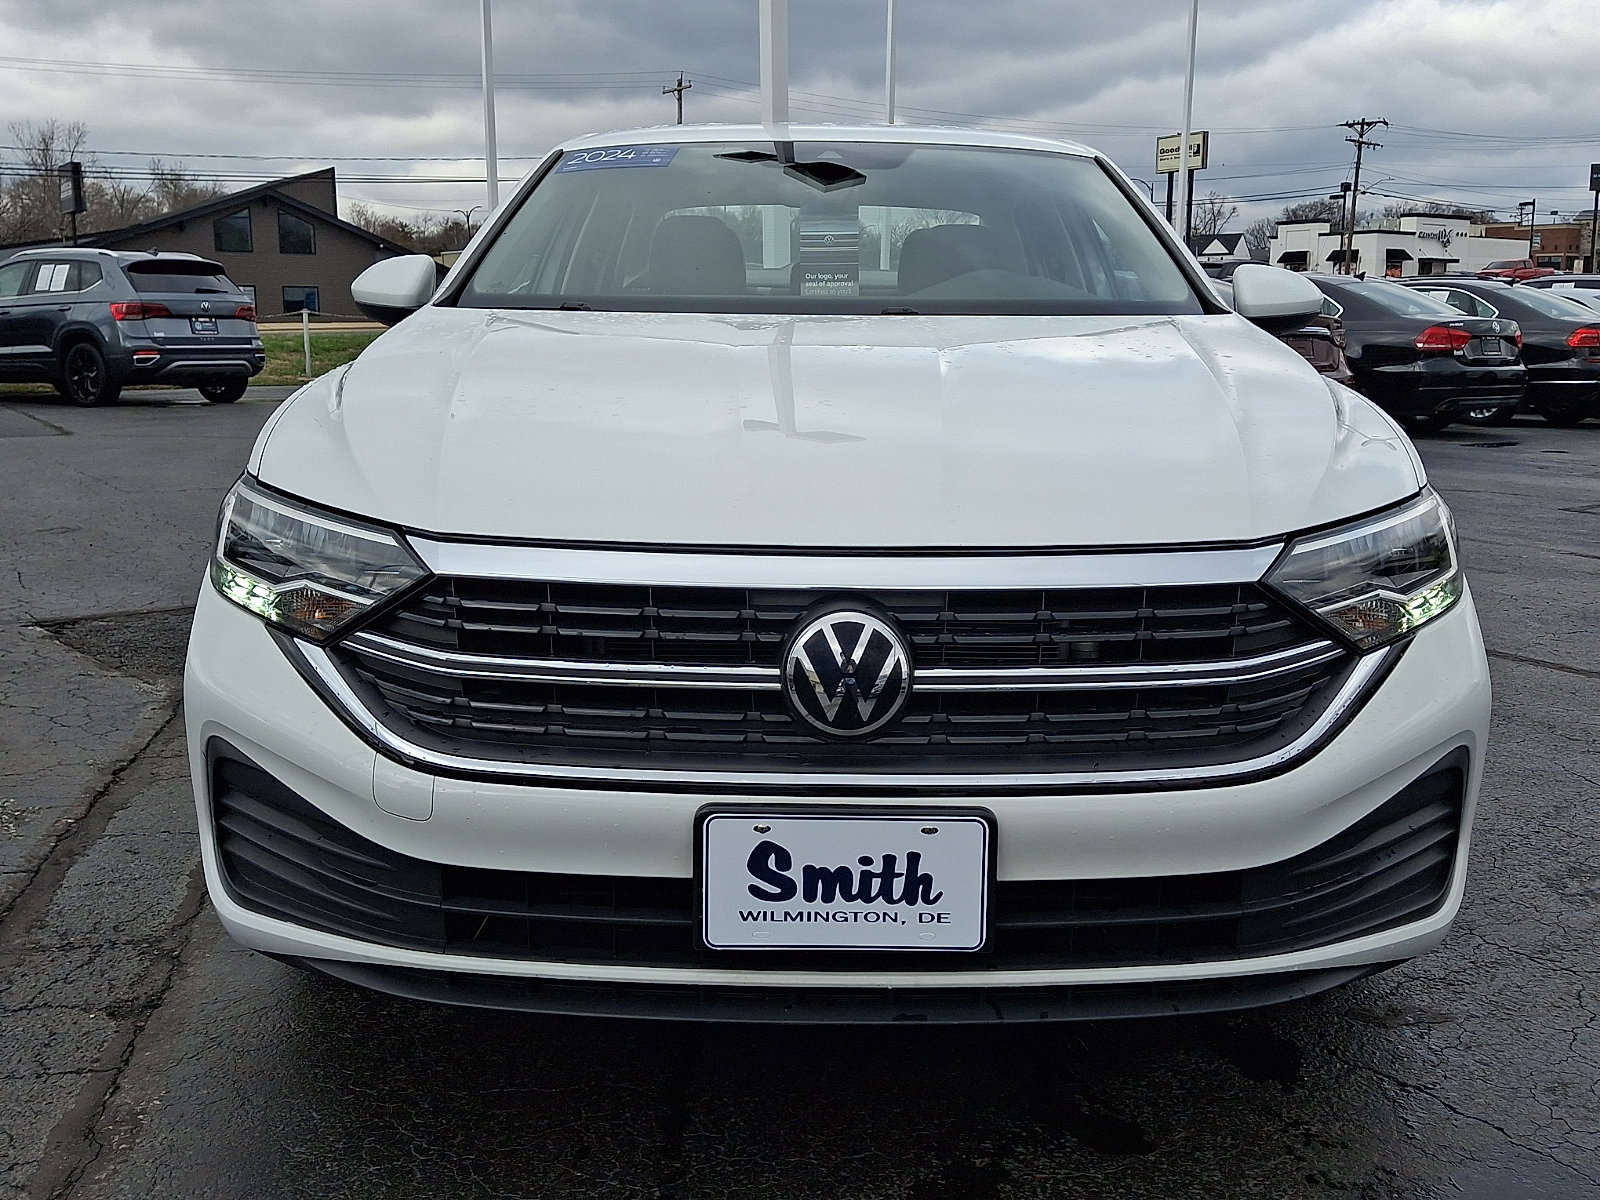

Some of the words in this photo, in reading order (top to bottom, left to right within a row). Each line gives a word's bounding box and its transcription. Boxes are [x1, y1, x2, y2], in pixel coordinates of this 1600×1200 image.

[567, 148, 636, 165] 2024
[1160, 144, 1192, 154] Goodll
[826, 280, 854, 288] approval
[746, 839, 944, 906] Smith
[738, 910, 907, 926] WILMINGTON,
[918, 912, 952, 924] DE
